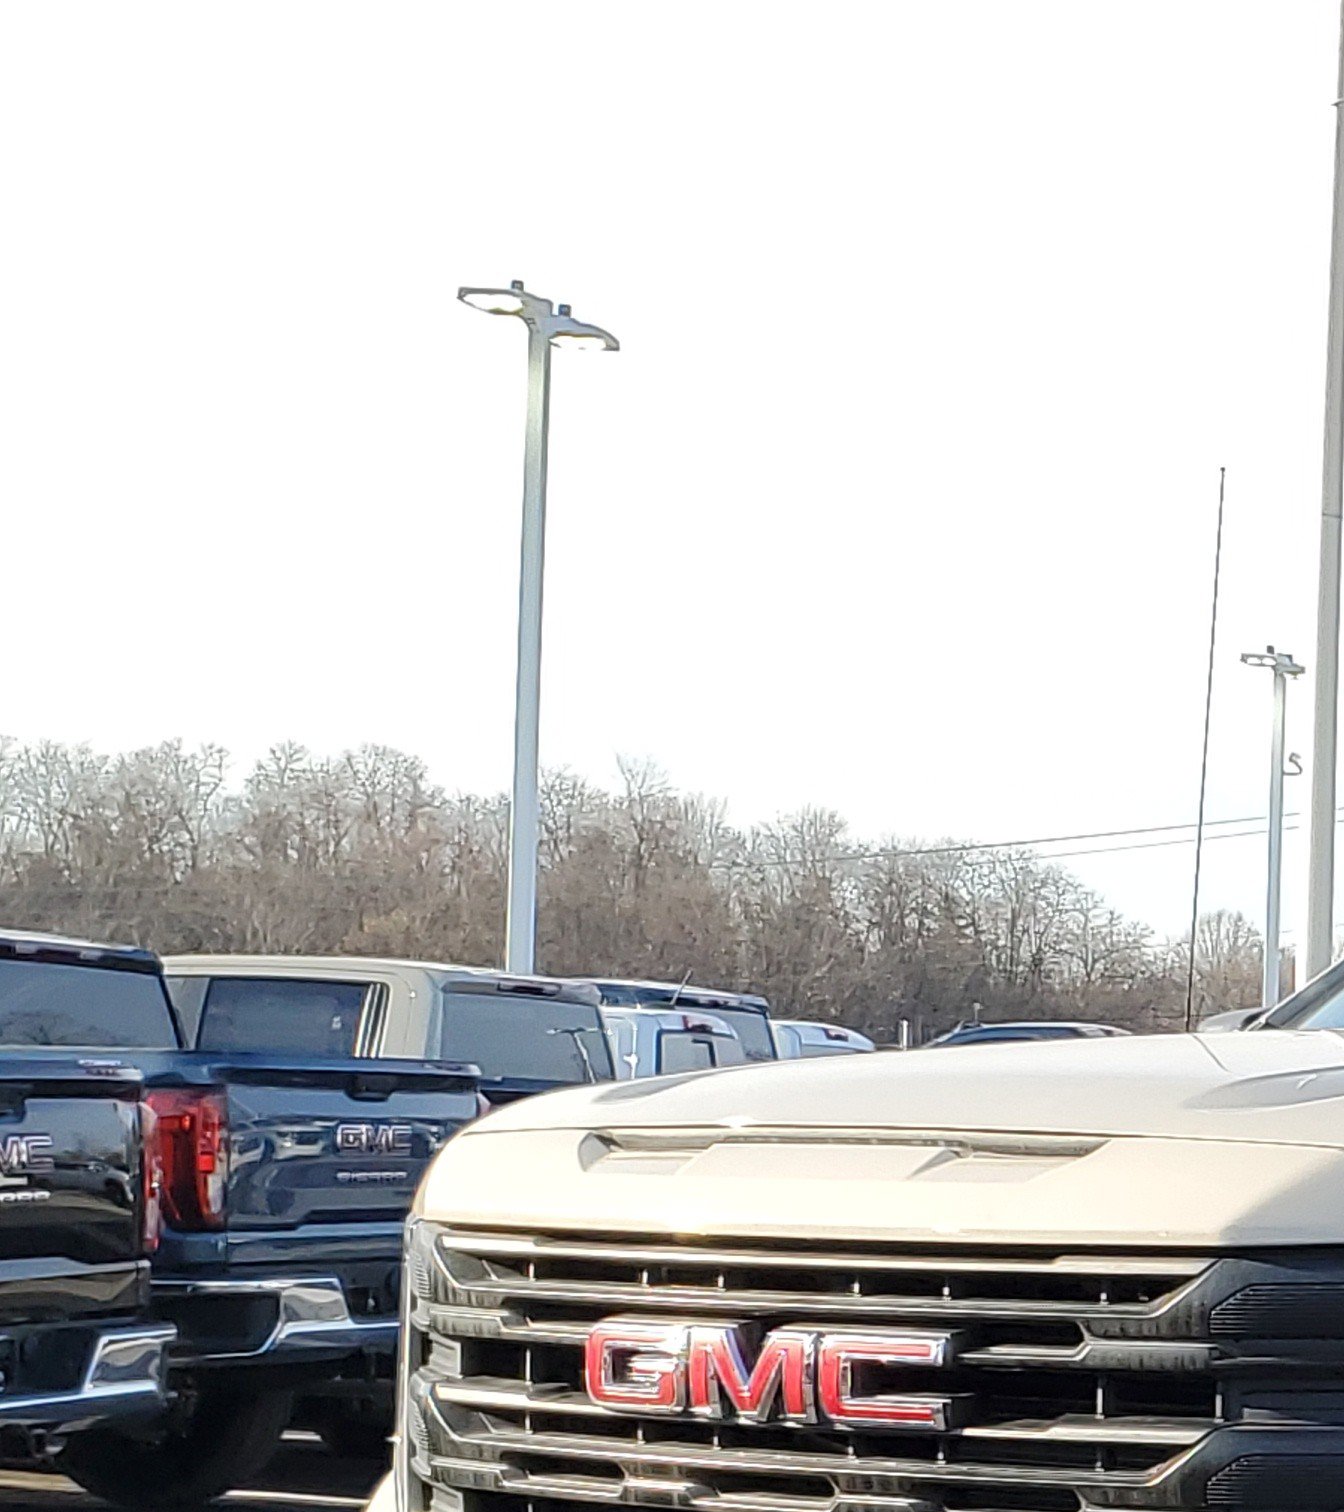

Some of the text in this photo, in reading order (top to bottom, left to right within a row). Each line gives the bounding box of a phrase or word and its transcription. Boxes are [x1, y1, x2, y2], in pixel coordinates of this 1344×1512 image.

[0, 1135, 54, 1173] MC
[336, 1124, 413, 1156] GMC
[585, 1316, 953, 1430] GMC
